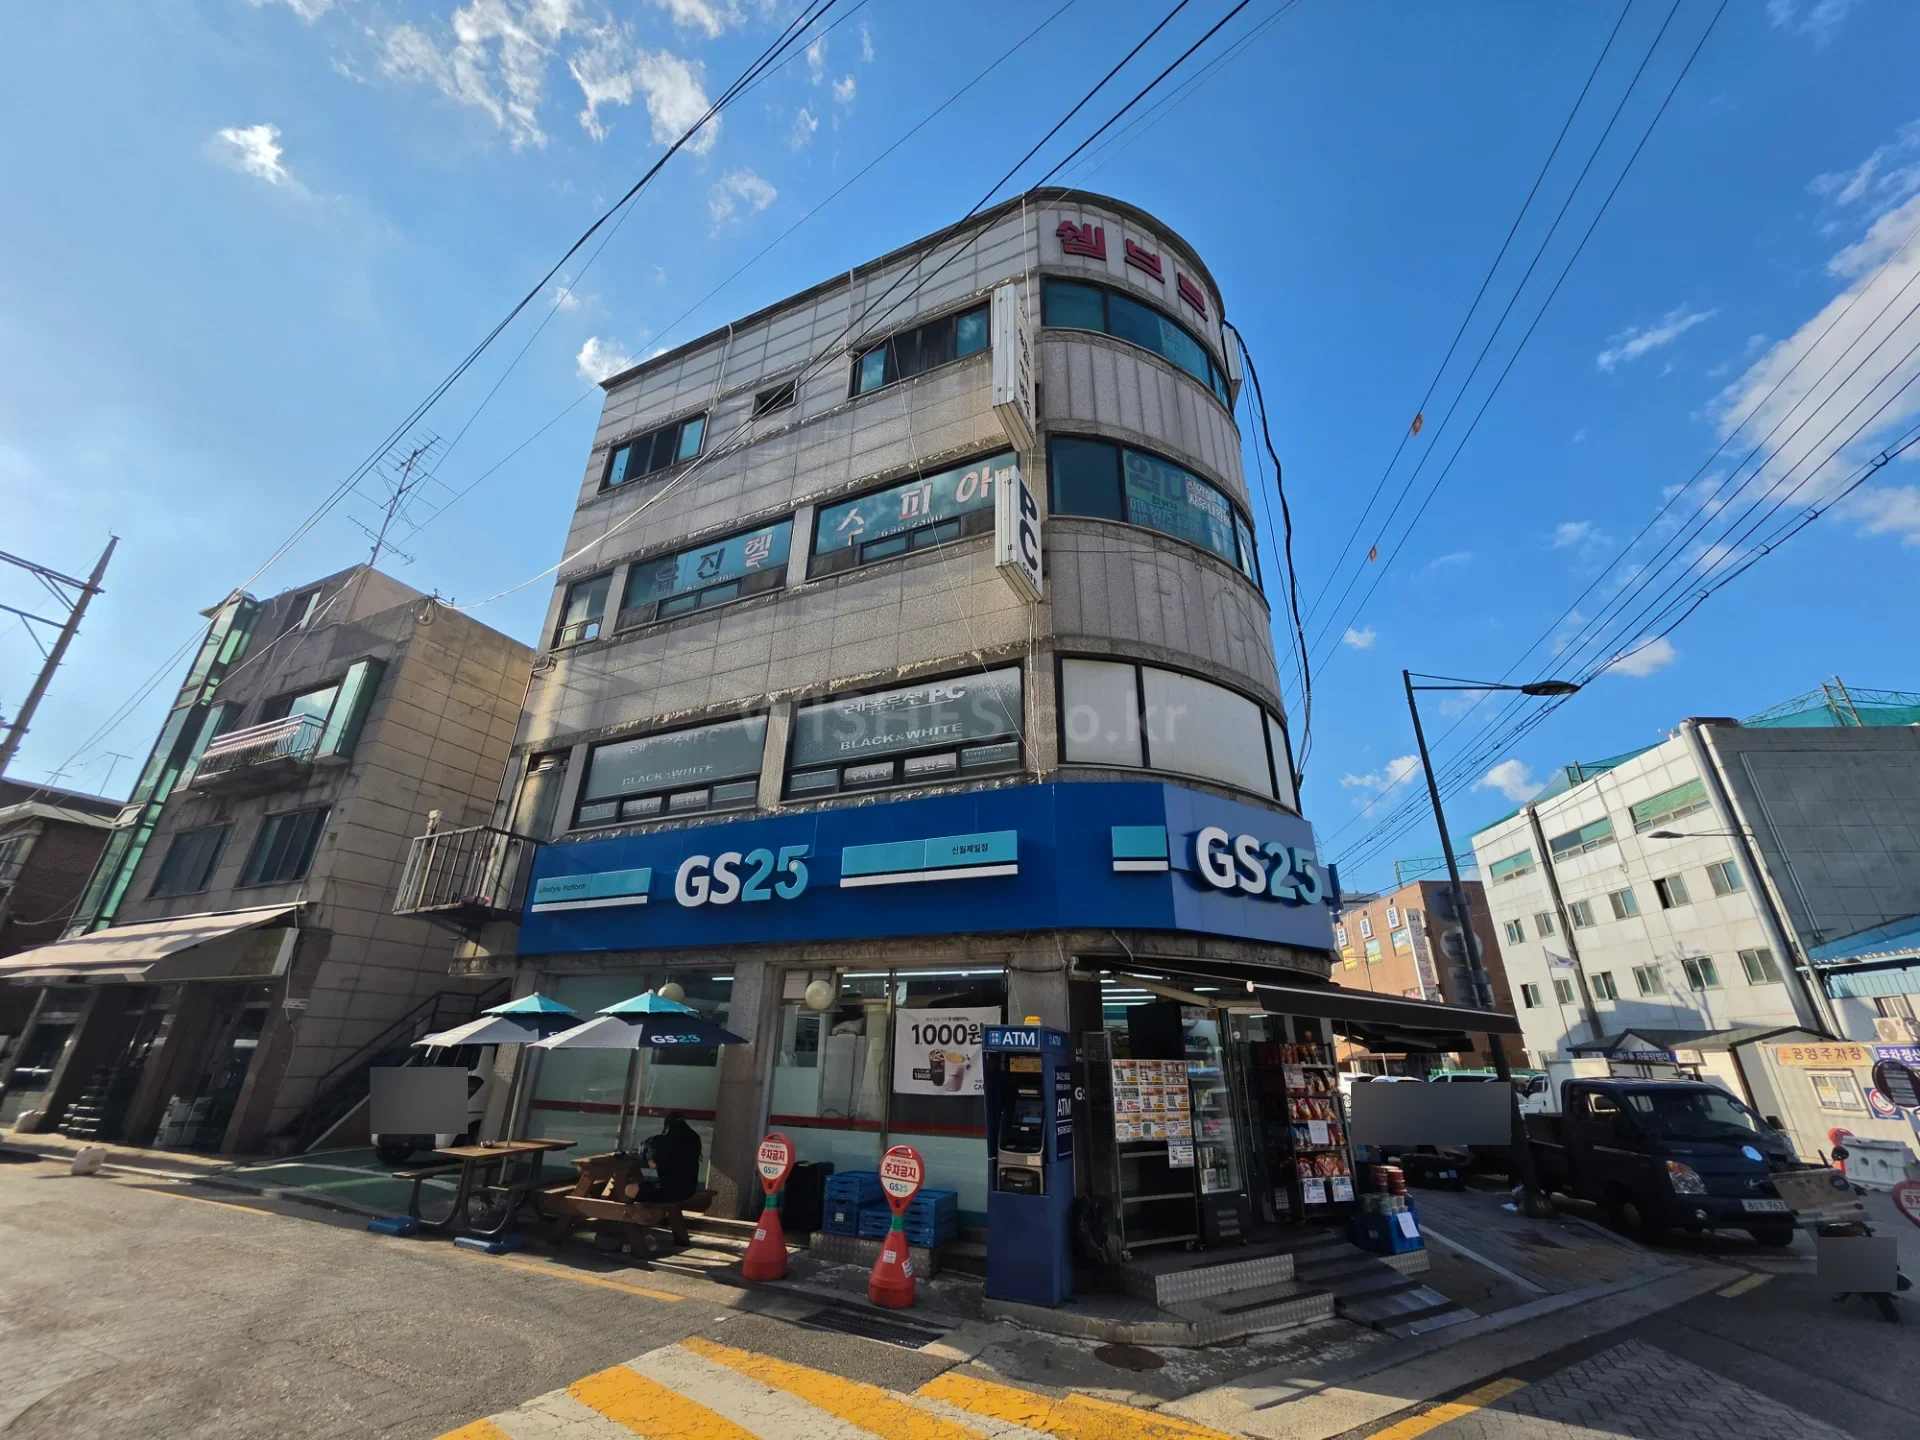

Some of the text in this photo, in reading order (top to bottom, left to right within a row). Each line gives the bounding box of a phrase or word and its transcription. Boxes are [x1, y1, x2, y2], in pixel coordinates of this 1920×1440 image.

[1019, 478, 1038, 572] PC
[1022, 562, 1038, 589] CAFE
[928, 683, 967, 703] PC
[951, 842, 989, 855] 신월제일점
[1196, 825, 1323, 905] GS25
[675, 844, 810, 908] GS25
[538, 882, 587, 895] Lifestyle Platform
[650, 1033, 701, 1044] GS25
[1002, 1031, 1036, 1046] ATM
[1791, 1046, 1863, 1060] 공영주차장
[1056, 1097, 1072, 1117] ATM
[760, 1148, 786, 1162] 주차금지
[763, 1166, 779, 1175] GS25
[884, 1162, 917, 1180] 주차금지
[889, 1182, 909, 1193] GS25
